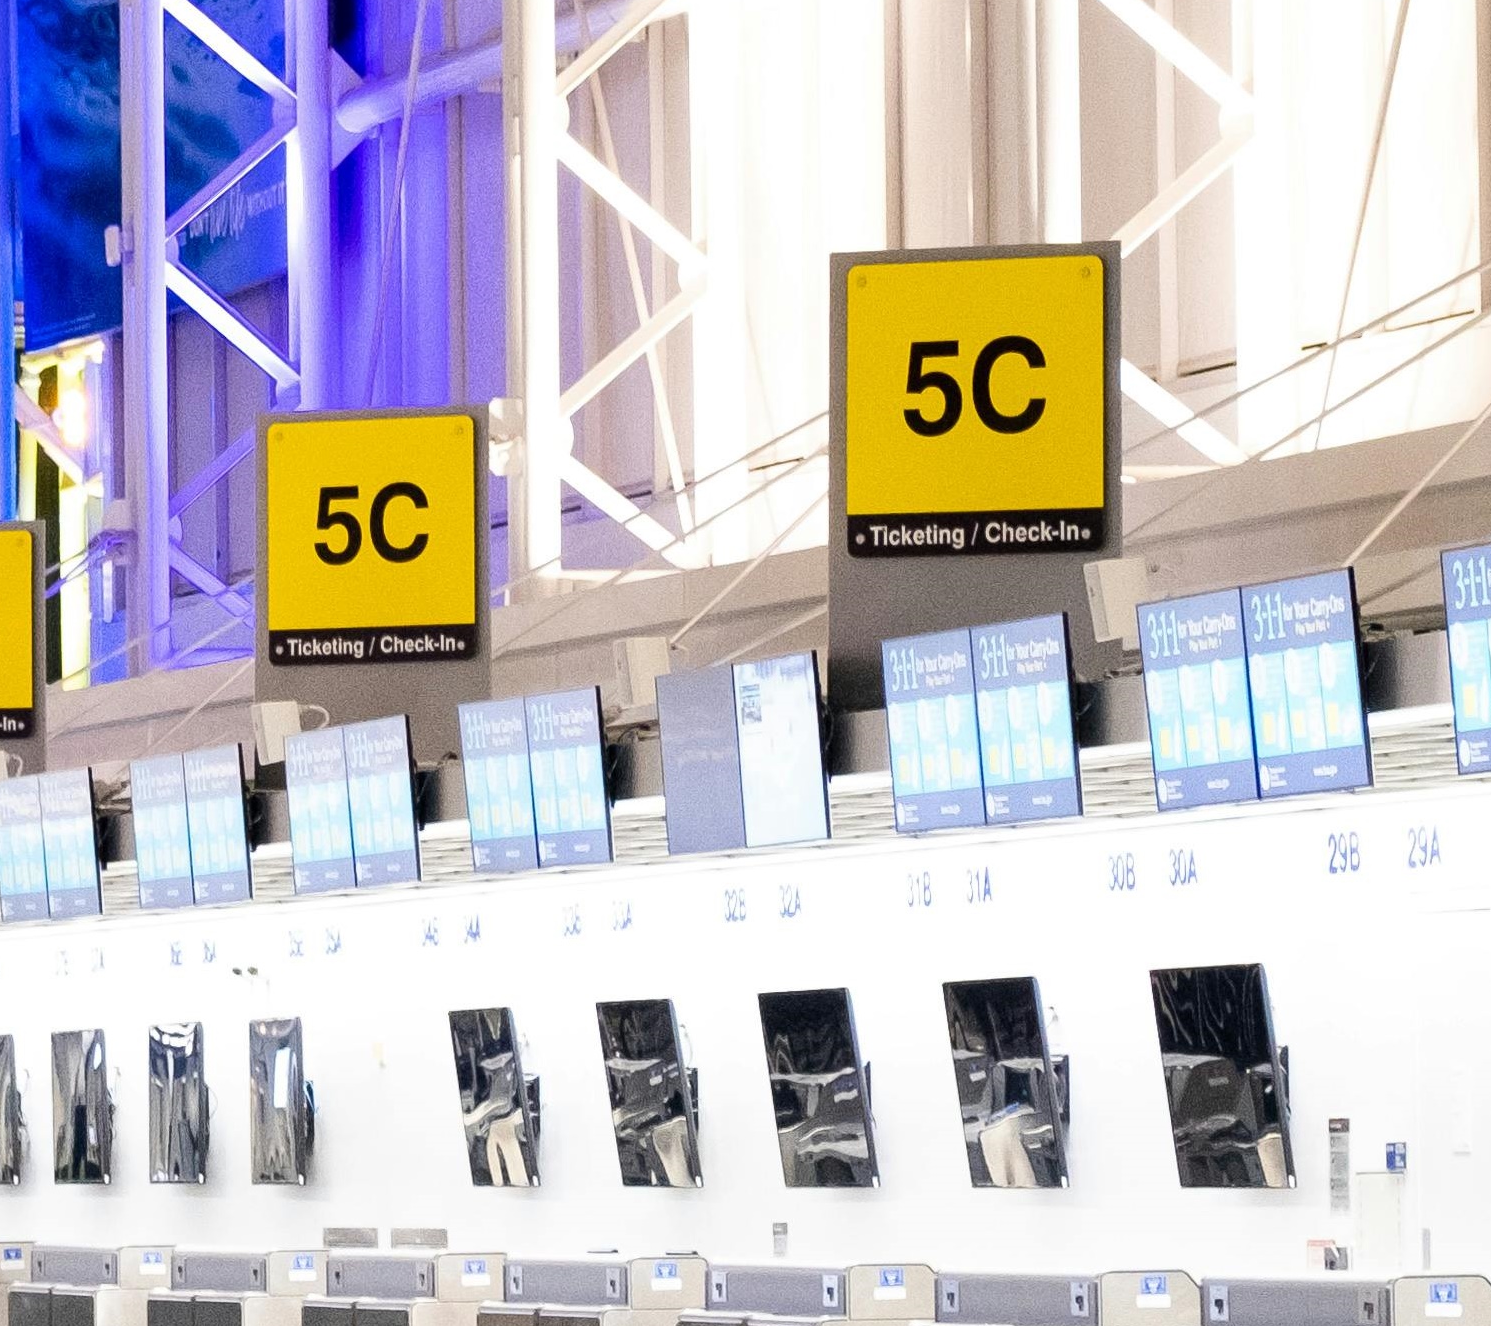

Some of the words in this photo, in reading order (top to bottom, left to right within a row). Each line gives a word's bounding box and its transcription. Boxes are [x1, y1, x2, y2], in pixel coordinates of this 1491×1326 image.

[903, 335, 1047, 438] 5C
[313, 481, 430, 565] 5C
[869, 522, 965, 549] Ticketing
[985, 520, 1080, 544] Check-In
[1453, 555, 1491, 610] 3-1-1
[1147, 609, 1181, 659] 3-1-1
[1252, 592, 1287, 643] 3-1-1
[286, 637, 365, 659] Ticketing
[380, 635, 456, 654] Check-In
[1169, 847, 1198, 886] 30A
[1328, 831, 1361, 874] 29B
[1407, 825, 1442, 869] 29A
[1107, 851, 1136, 891] 30B
